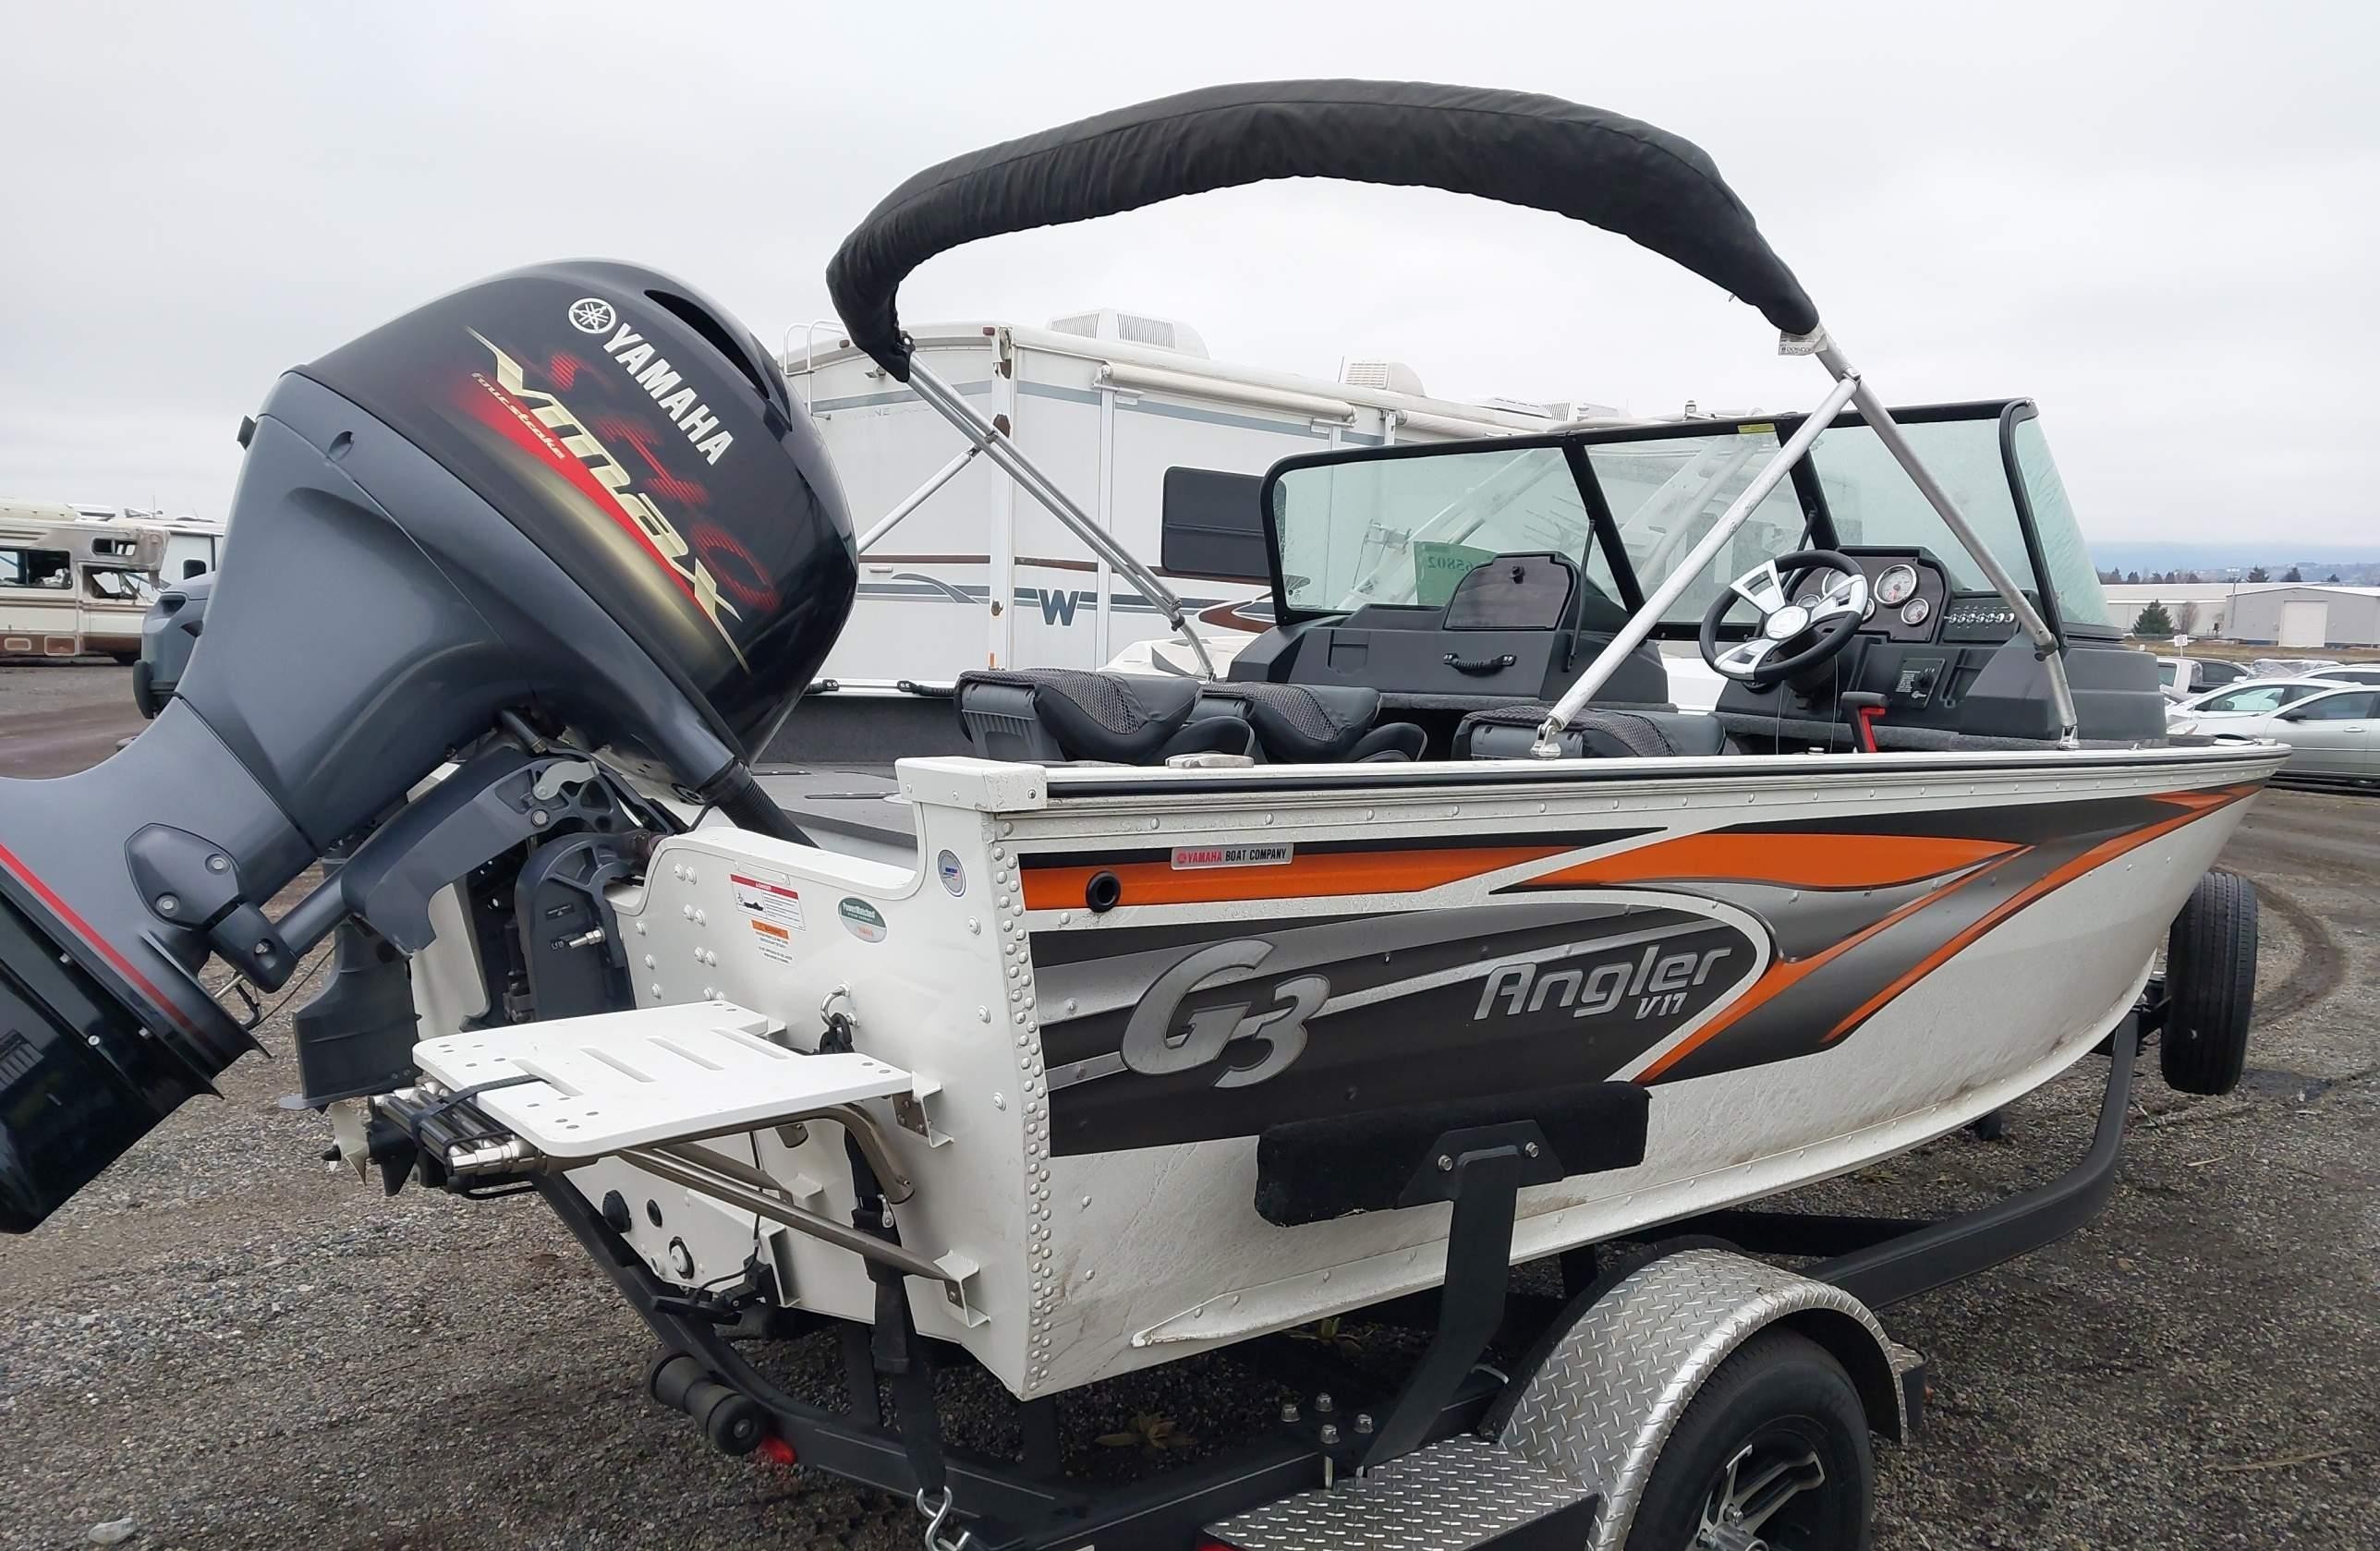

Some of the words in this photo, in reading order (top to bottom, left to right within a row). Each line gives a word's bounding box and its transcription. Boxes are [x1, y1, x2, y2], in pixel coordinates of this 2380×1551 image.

[603, 322, 734, 466] YAMAHA
[1038, 588, 1080, 626] W
[1188, 851, 1221, 864] YAMAHA
[1225, 850, 1247, 861] BOAT
[1249, 848, 1287, 860] COMPANY
[1473, 944, 1733, 1020] Angler
[1634, 991, 1689, 1020] V17
[1121, 937, 1331, 1088] G3
